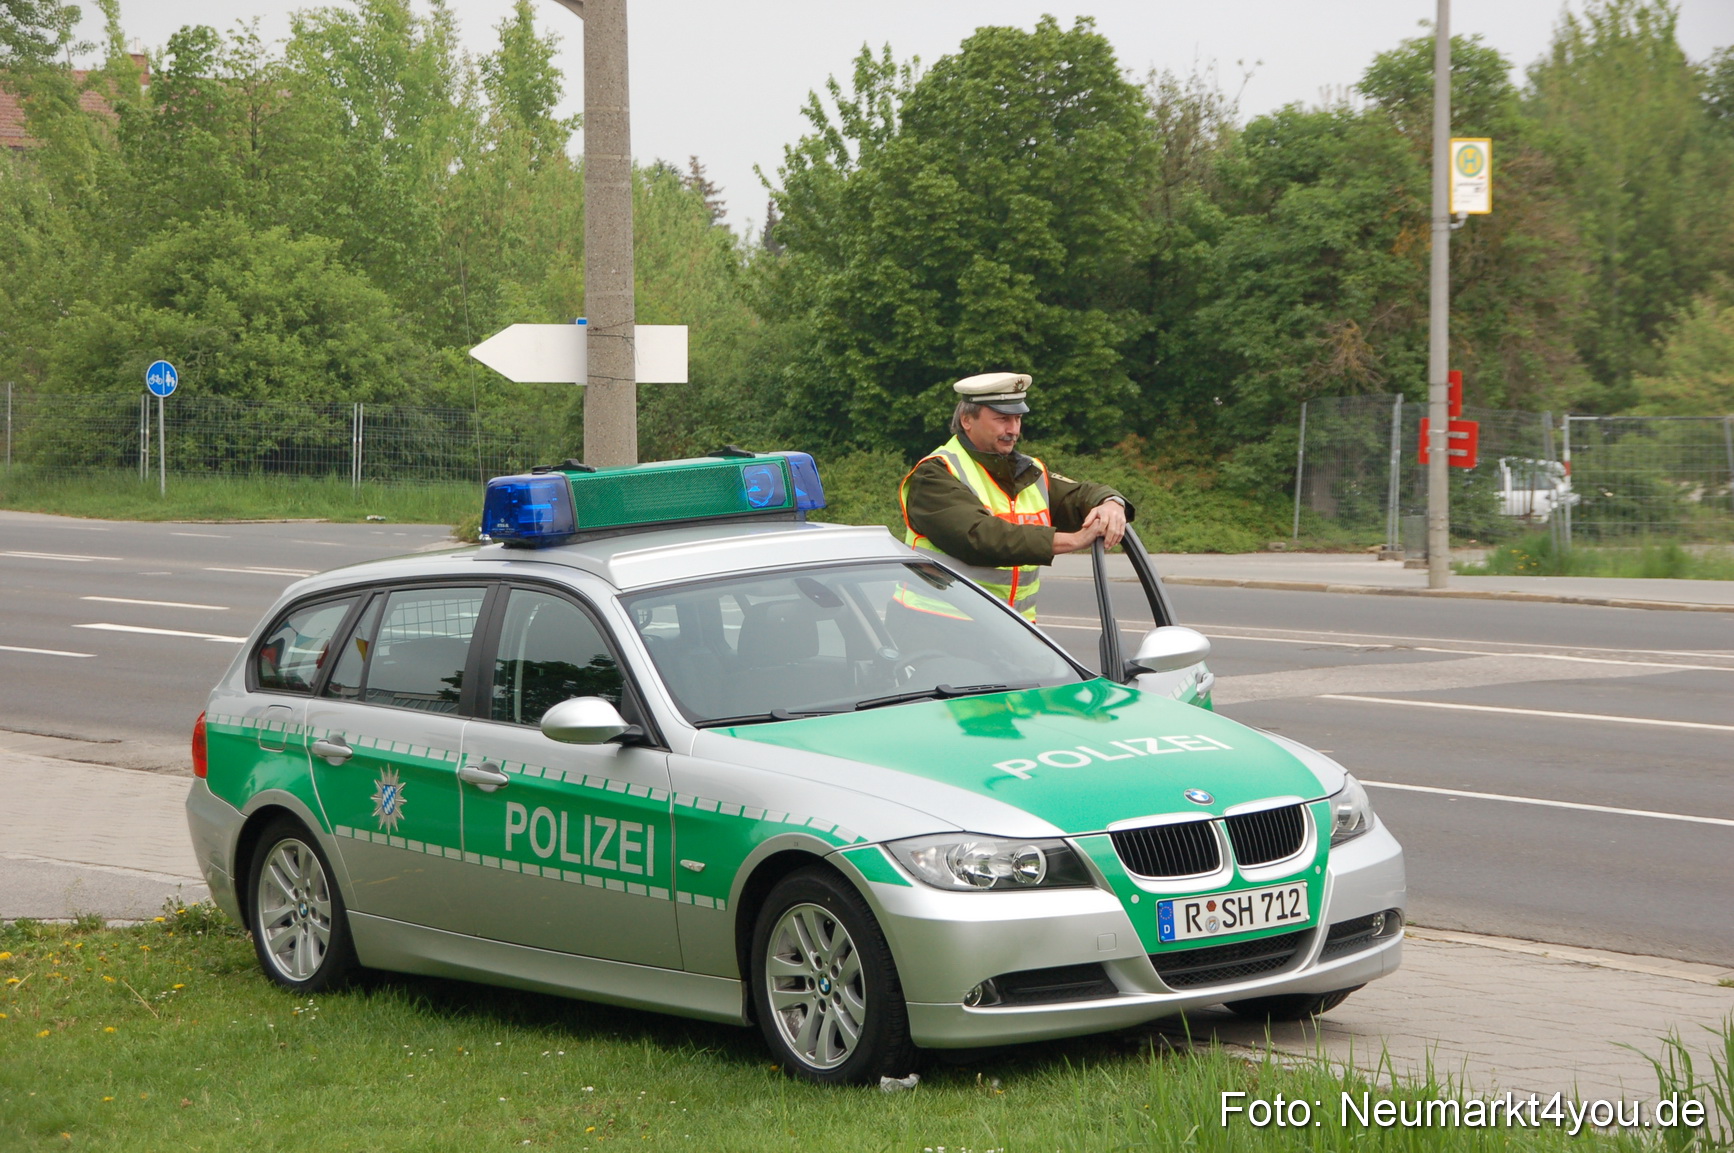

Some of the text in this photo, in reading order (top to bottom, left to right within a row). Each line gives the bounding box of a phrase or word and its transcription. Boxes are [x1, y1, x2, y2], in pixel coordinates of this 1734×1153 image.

[1463, 152, 1477, 169] H
[991, 734, 1235, 781] POLIZEI
[505, 800, 655, 877] POLIZEI
[1163, 924, 1171, 934] D
[1185, 888, 1302, 933] R SH 712
